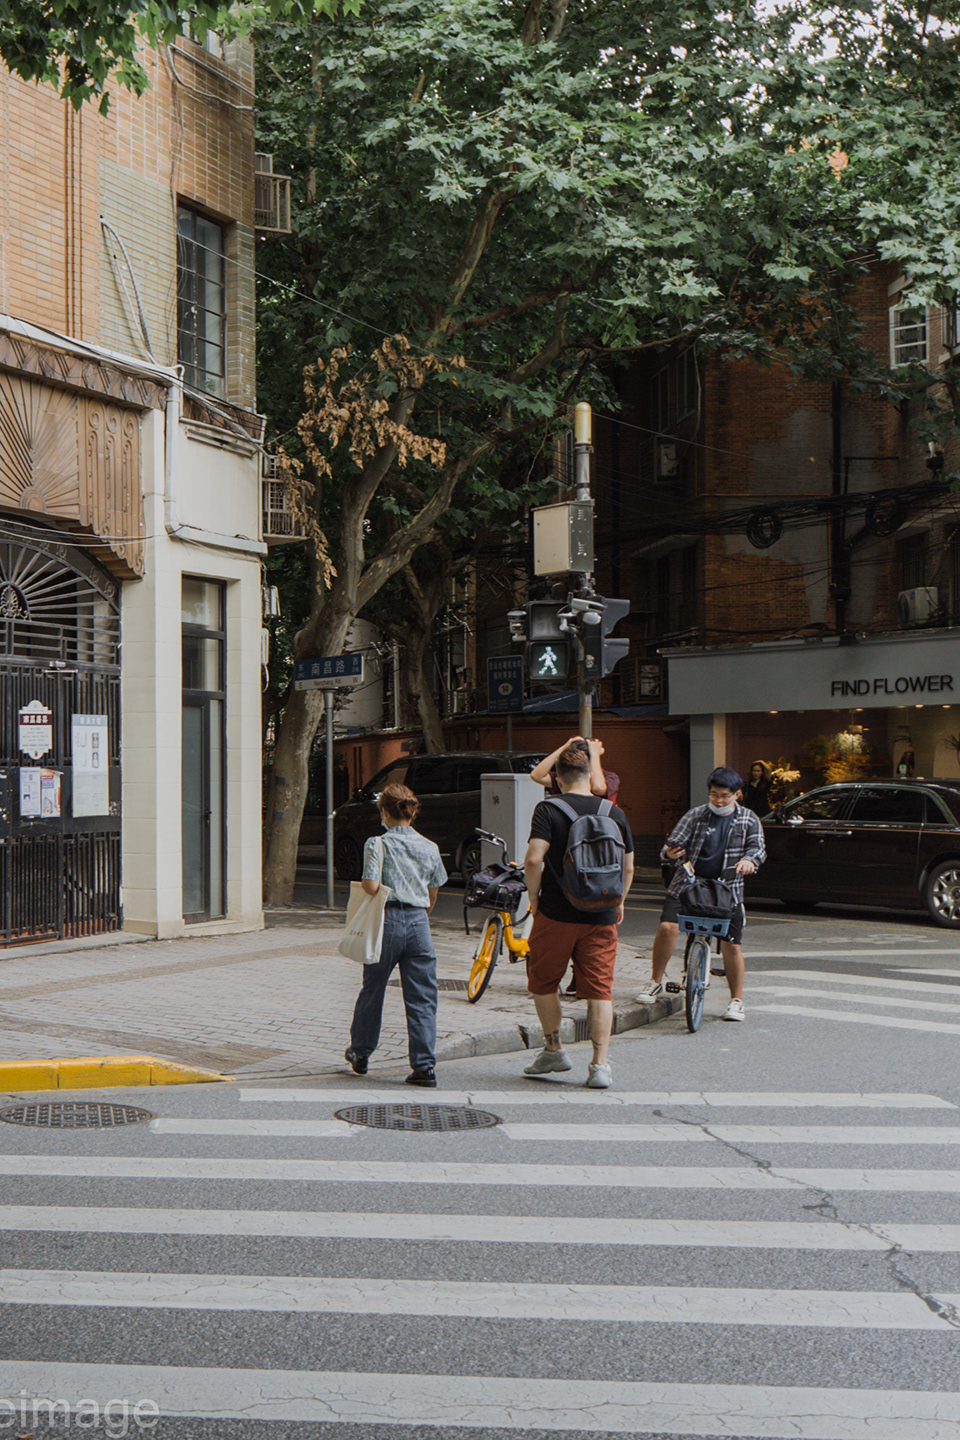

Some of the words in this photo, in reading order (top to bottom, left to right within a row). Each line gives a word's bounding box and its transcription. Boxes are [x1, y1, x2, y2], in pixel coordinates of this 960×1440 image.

[311, 659, 345, 676] 南昌路
[298, 681, 303, 689] E
[352, 676, 359, 684] W
[831, 679, 870, 697] FIND
[873, 674, 954, 695] FLOWER
